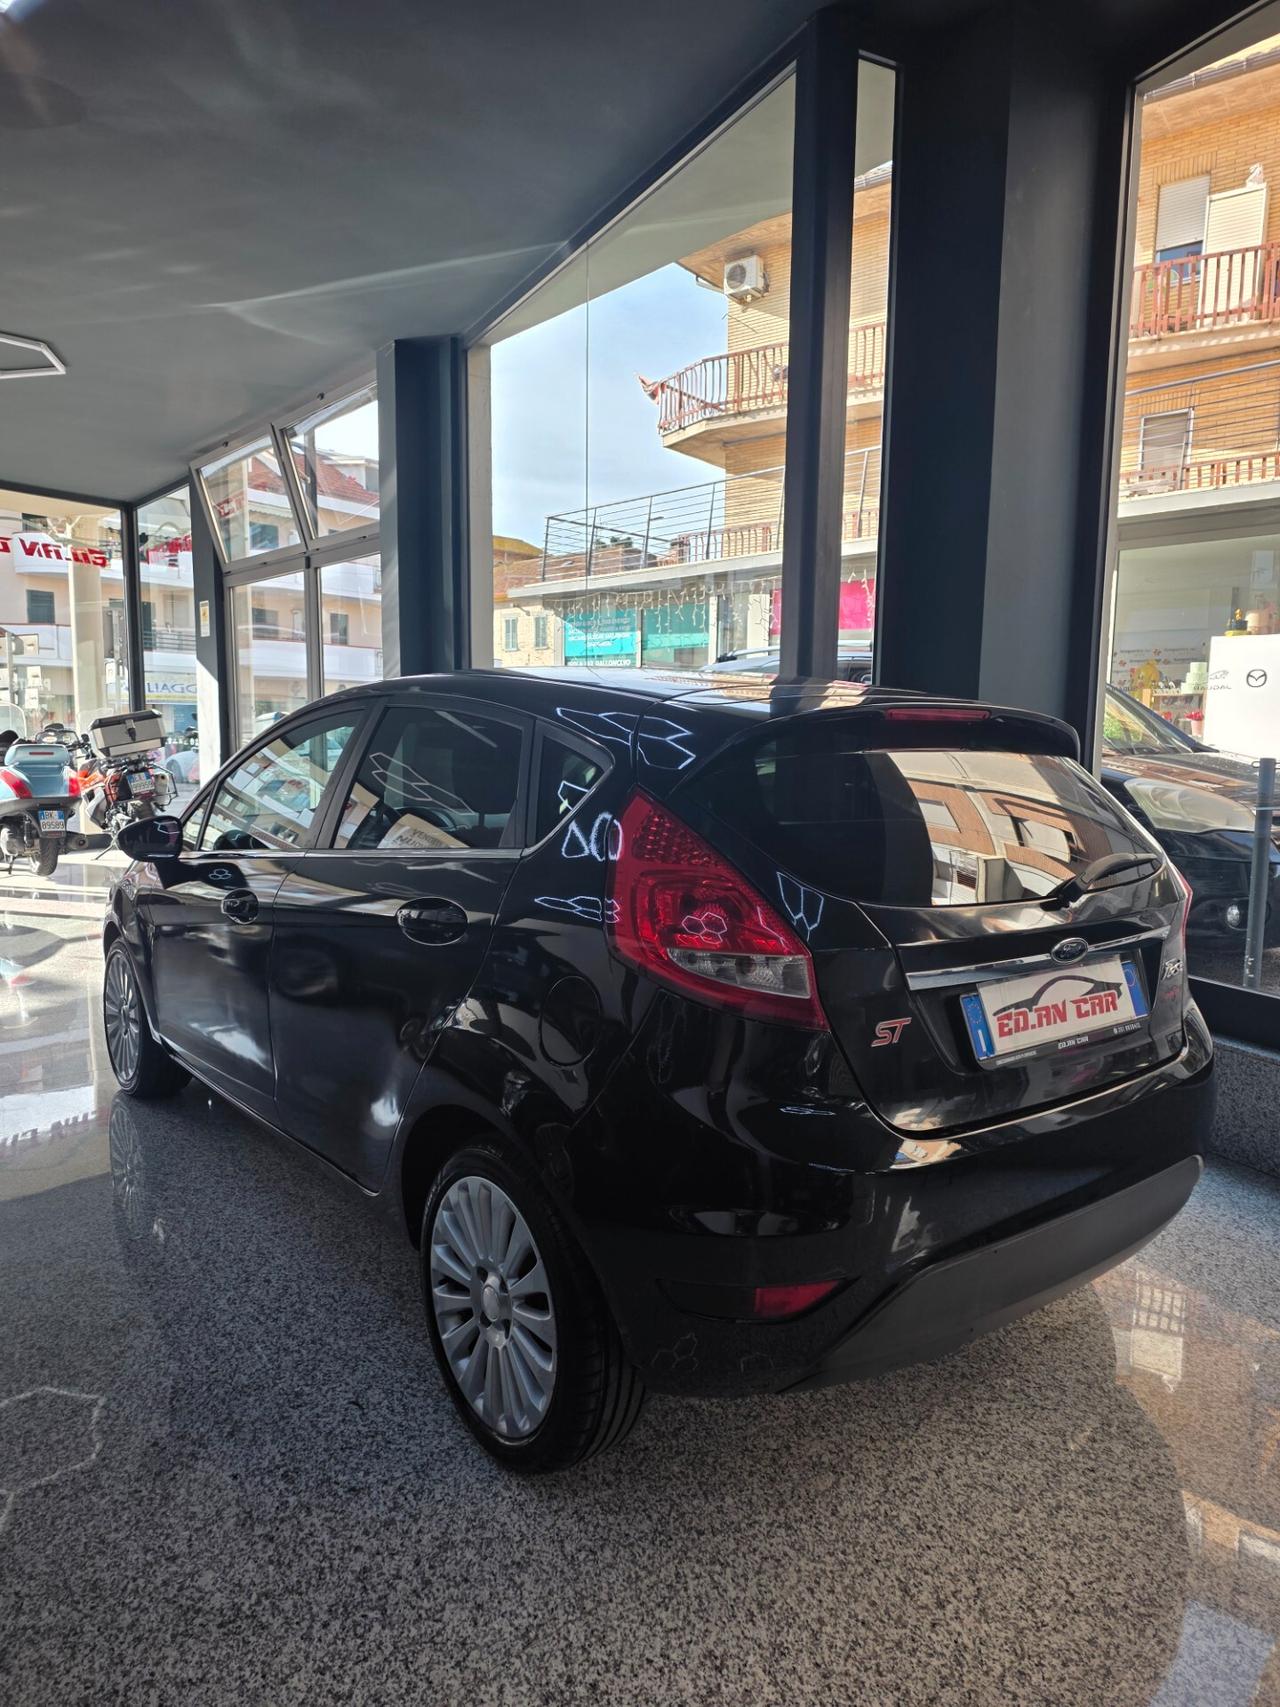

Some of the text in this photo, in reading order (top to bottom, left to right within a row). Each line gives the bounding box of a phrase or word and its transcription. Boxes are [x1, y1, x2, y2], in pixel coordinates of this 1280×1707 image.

[871, 1017, 912, 1048] ST
[997, 991, 1119, 1038] ED.AN CAR
